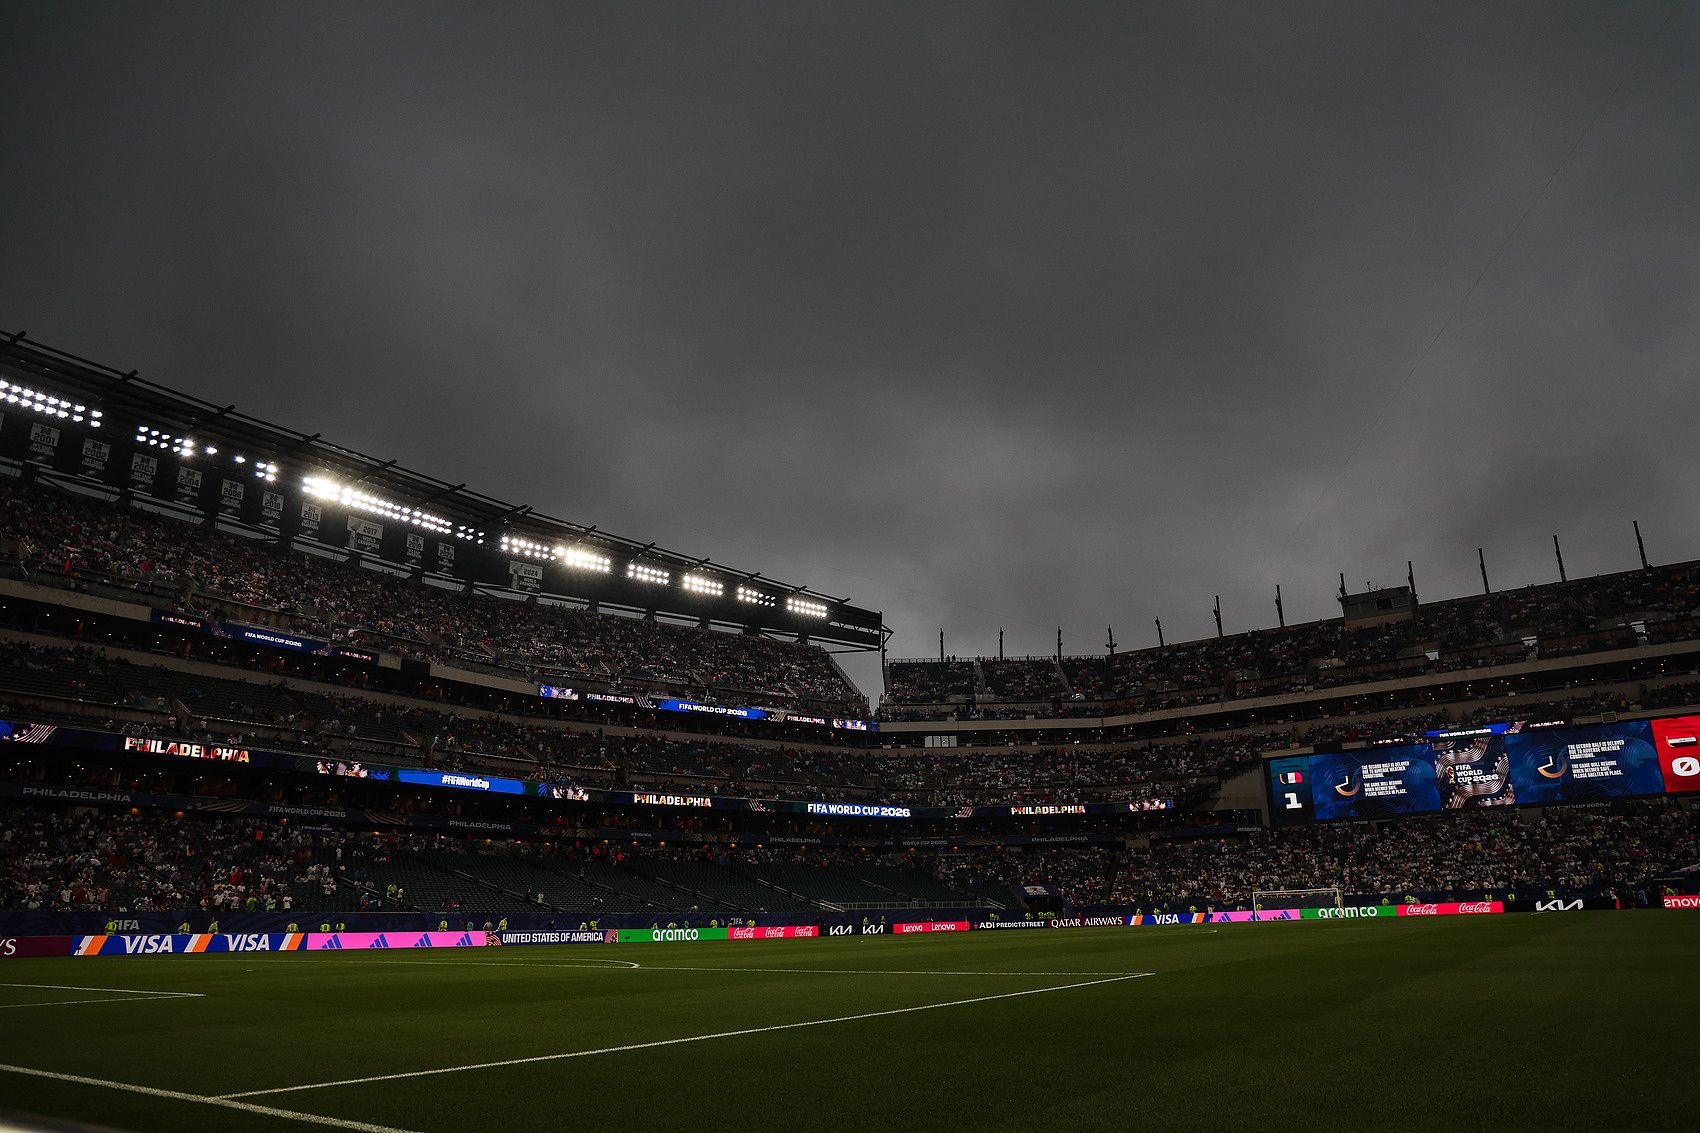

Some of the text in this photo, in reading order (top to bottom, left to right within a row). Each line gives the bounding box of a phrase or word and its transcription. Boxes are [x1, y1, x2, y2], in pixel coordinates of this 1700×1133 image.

[34, 433, 56, 445] 2001
[85, 447, 107, 460] 2002
[133, 461, 155, 474] 2003
[179, 475, 199, 486] 2004
[363, 525, 378, 536] 2017
[523, 568, 538, 577] 2024
[245, 632, 302, 647] FIFA WORLD CUP 2026
[587, 693, 634, 704] PHILADELPHIA
[692, 705, 714, 714] WORLD
[715, 707, 726, 715] CUP
[727, 708, 748, 717] 2026
[124, 737, 250, 763] PHILADELPHIA
[1672, 757, 1700, 777] 0
[442, 775, 490, 790] #FIFAWorldCup
[1473, 774, 1499, 783] 2026
[23, 787, 132, 803] PHILADELPHIA
[633, 794, 712, 808] PHILADELPHIA
[1285, 793, 1303, 809] 1
[283, 807, 308, 816] WORLD
[309, 809, 323, 817] CUP
[323, 810, 346, 818] 2026
[808, 804, 911, 818] FIFA WORLD CUP 2026
[1011, 805, 1086, 815] PHILADELPHIA
[449, 820, 512, 831] PHILADELPHIA
[1032, 836, 1089, 844] PHILADELPHIA
[1459, 902, 1491, 914] Coca-Cola
[1536, 899, 1584, 911] KIA
[1664, 898, 1700, 907] enov
[1318, 907, 1377, 919] aramco
[1407, 904, 1438, 916] Coca-Cola
[979, 921, 995, 929] ADI
[1051, 916, 1123, 928] QATAR AIRWAYS
[1152, 914, 1179, 924] VISA
[765, 927, 784, 938] Coca-Cola
[795, 926, 813, 937] Coca-Cola
[829, 925, 852, 936] KIA
[862, 924, 883, 935] KIA
[903, 923, 923, 932] Lenovo
[931, 922, 956, 931] Lenovo
[503, 932, 603, 943] UNITED STATES OF AMERICA
[653, 929, 698, 942] aramco
[734, 927, 754, 939] Coca-Cola
[120, 935, 173, 954] VISA
[223, 934, 270, 952] VISA
